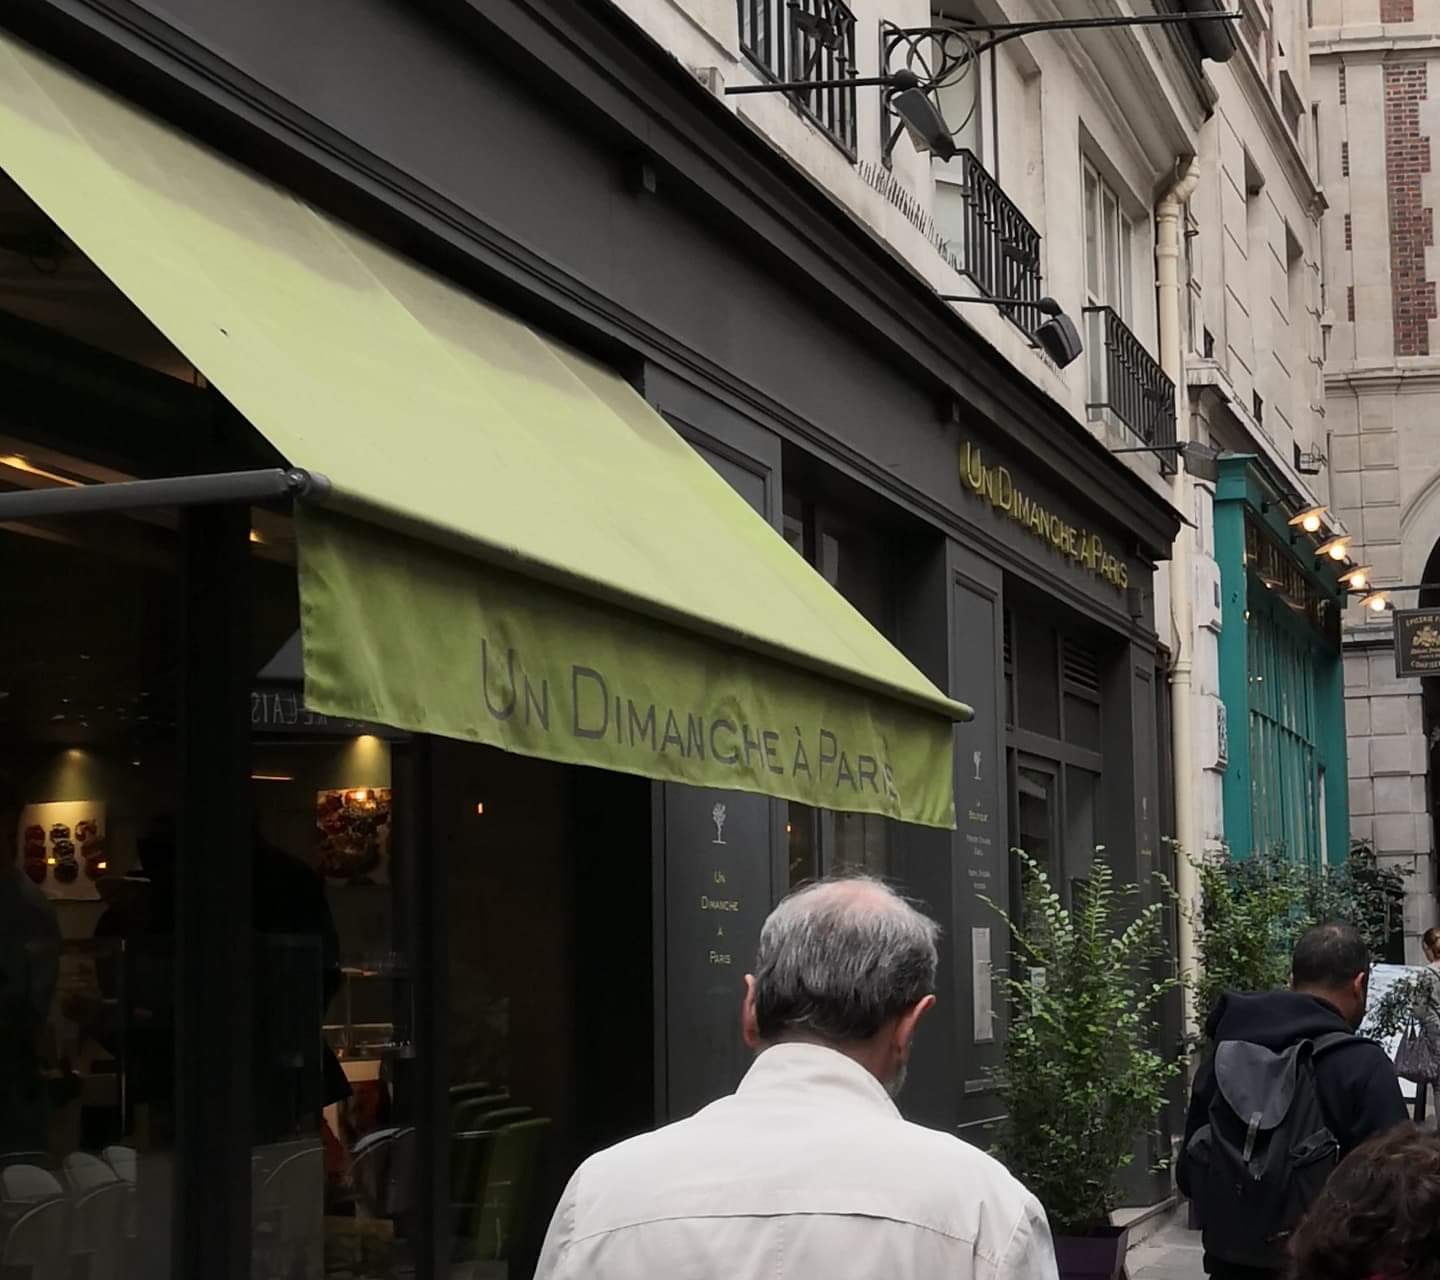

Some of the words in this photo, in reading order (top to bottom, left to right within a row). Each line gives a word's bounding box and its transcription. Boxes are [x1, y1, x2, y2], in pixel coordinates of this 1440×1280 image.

[993, 465, 1079, 556] DIMANCHE
[1090, 535, 1129, 589] PARIS
[480, 638, 549, 732] UN
[571, 664, 785, 776] DIMANCHE
[792, 725, 812, 781] À
